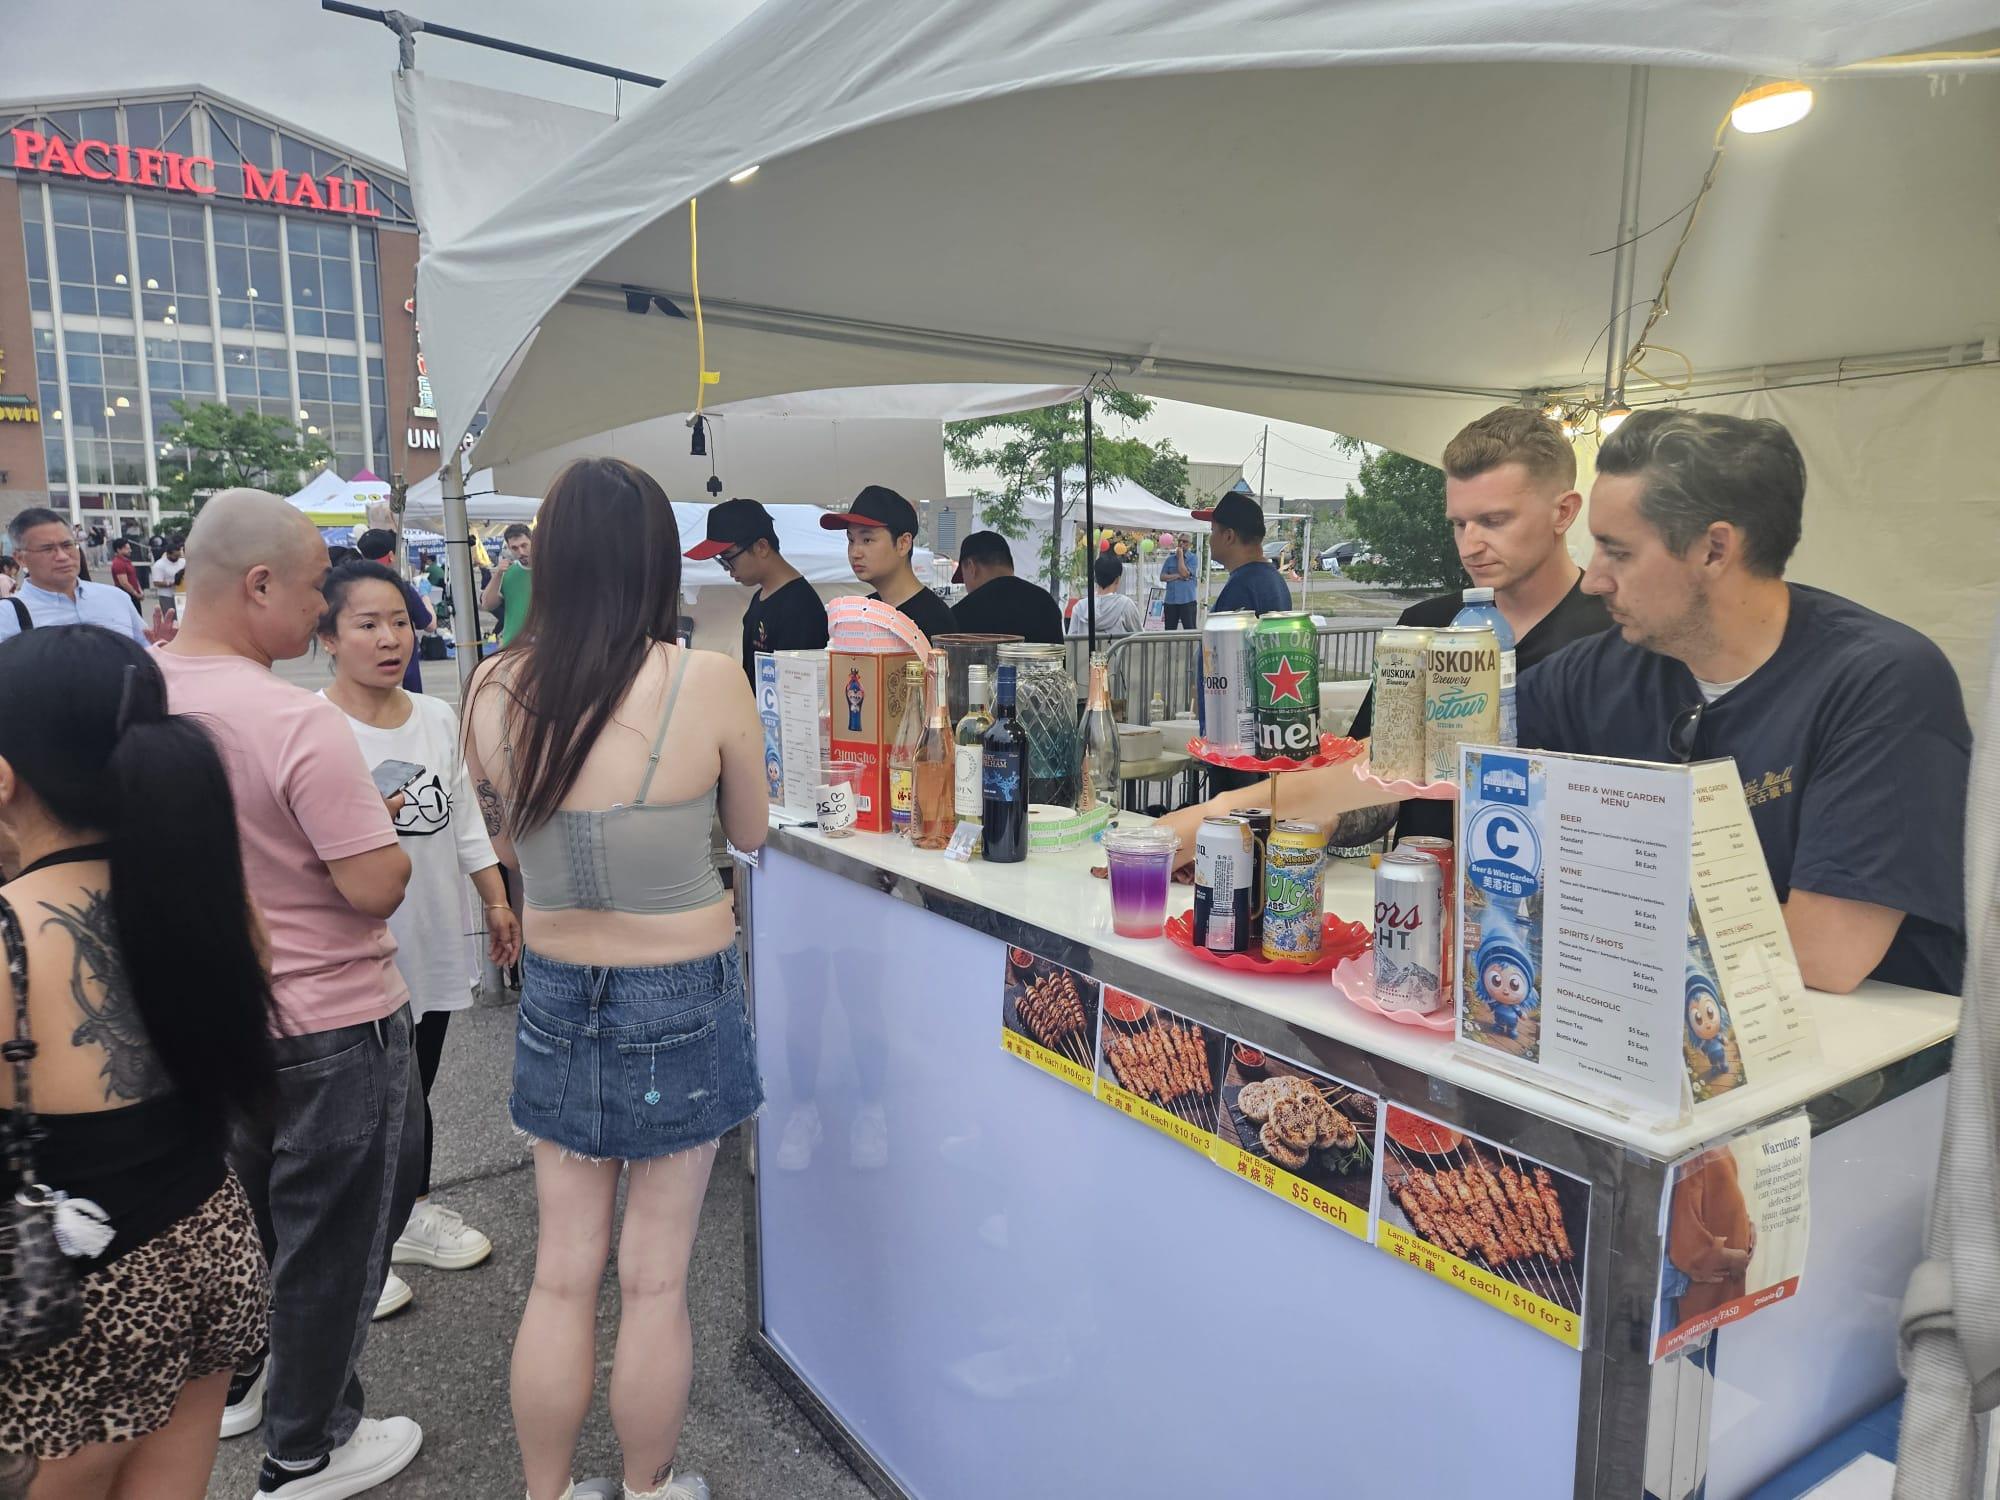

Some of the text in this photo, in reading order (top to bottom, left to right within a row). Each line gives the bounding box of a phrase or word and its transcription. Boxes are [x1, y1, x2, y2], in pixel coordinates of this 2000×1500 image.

[11, 128, 381, 217] PACIFIC MALL
[1427, 649, 1496, 673] USKOKA
[1381, 669, 1416, 680] MUSKOKA
[1432, 673, 1471, 688] Brewery
[1205, 676, 1229, 690] ORO
[1426, 687, 1488, 722] Detour
[1568, 783, 1590, 793] BEER
[1601, 787, 1624, 797] WINE
[1627, 791, 1665, 804] GARDEN
[1601, 797, 1629, 808] MENU
[1560, 814, 1582, 823] BEER
[1486, 816, 1520, 859] C
[1560, 836, 1583, 845] Standard
[1560, 846, 1583, 856] Premium
[1644, 850, 1657, 858] Each
[1560, 866, 1582, 877] WINE
[1643, 862, 1656, 870] Each
[1471, 864, 1487, 874] Beer
[1493, 868, 1509, 879] Wine
[1510, 872, 1535, 885] Garden
[1560, 893, 1583, 902] Standard
[1375, 901, 1423, 930] ors
[1560, 903, 1584, 914] Sparkling
[1643, 911, 1656, 920] Each
[1643, 922, 1656, 931] Each
[1559, 927, 1588, 941] SPIRITS
[1596, 937, 1624, 950] SHOTS
[1560, 951, 1582, 962] Standard
[1560, 962, 1581, 972] Premium
[1641, 973, 1654, 982] Each
[1633, 982, 1658, 994] $10 Each
[1557, 987, 1621, 1012] NON-ALCOHOLIC
[1556, 1017, 1583, 1030] Lemon Tea
[1577, 1011, 1603, 1023] Lemonade
[1556, 1032, 1588, 1047] Bottle Water
[1636, 1029, 1650, 1038] Each
[1635, 1043, 1649, 1051] Each
[1635, 1058, 1648, 1067] Each
[1044, 1054, 1059, 1069] each
[1063, 1063, 1075, 1078] $10
[1075, 1069, 1085, 1083] for
[1086, 1077, 1091, 1086] 3
[1106, 1093, 1132, 1114] 牛肉串
[1141, 1106, 1150, 1118] $4
[1150, 1112, 1168, 1129] each
[1174, 1123, 1188, 1139] $10
[1190, 1130, 1202, 1145] for
[1204, 1139, 1210, 1149] 3
[1761, 1135, 1800, 1157] Warning:
[1240, 1151, 1276, 1176] Flat Bread
[1237, 1160, 1275, 1189] 烤烧饼
[1291, 1182, 1347, 1224] $5 each
[1387, 1228, 1446, 1264] Lamb Skewers
[1393, 1243, 1436, 1273] 羊肉串
[1451, 1264, 1466, 1281] $4
[1469, 1275, 1500, 1297] each
[1512, 1294, 1536, 1314] $10
[1540, 1308, 1561, 1327] for
[1563, 1320, 1572, 1333] 3
